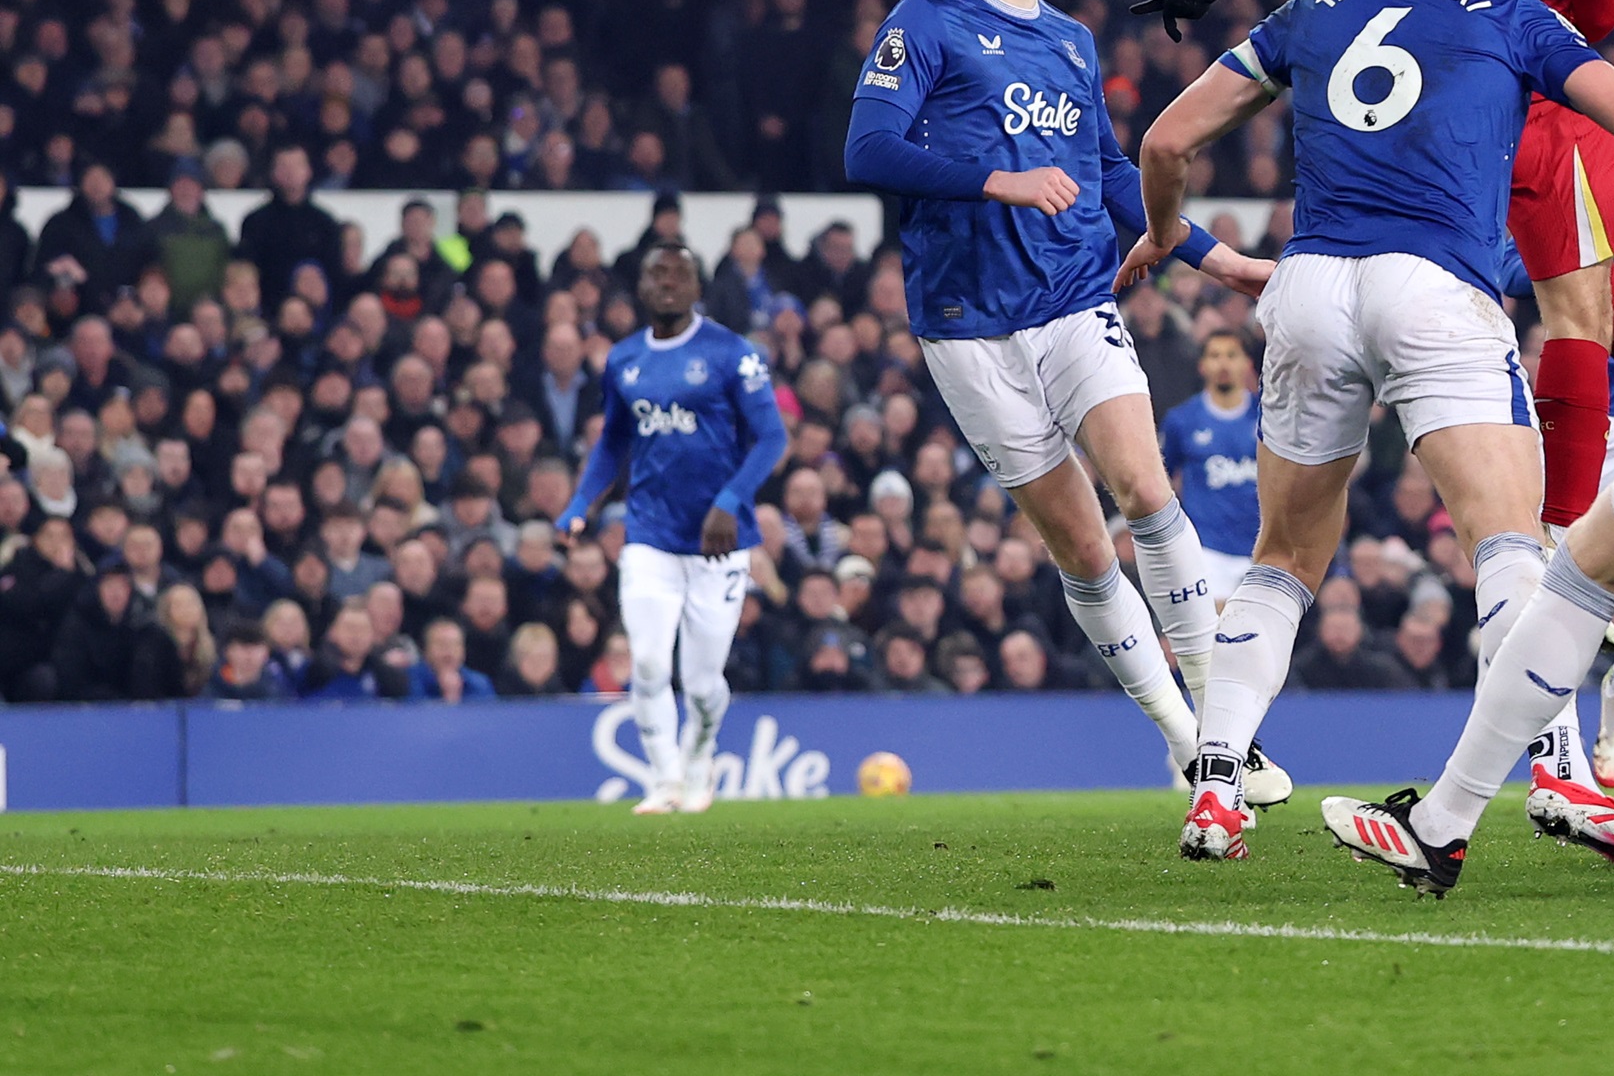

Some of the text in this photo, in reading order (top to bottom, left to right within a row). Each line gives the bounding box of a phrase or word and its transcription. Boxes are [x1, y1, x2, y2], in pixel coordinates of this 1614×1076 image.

[1327, 7, 1423, 132] 6
[1004, 82, 1082, 137] Stake
[632, 399, 697, 437] Stake
[1541, 420, 1555, 431] FC
[1169, 579, 1208, 604] EFC
[1098, 635, 1137, 657] EFC
[593, 700, 830, 801] Sake
